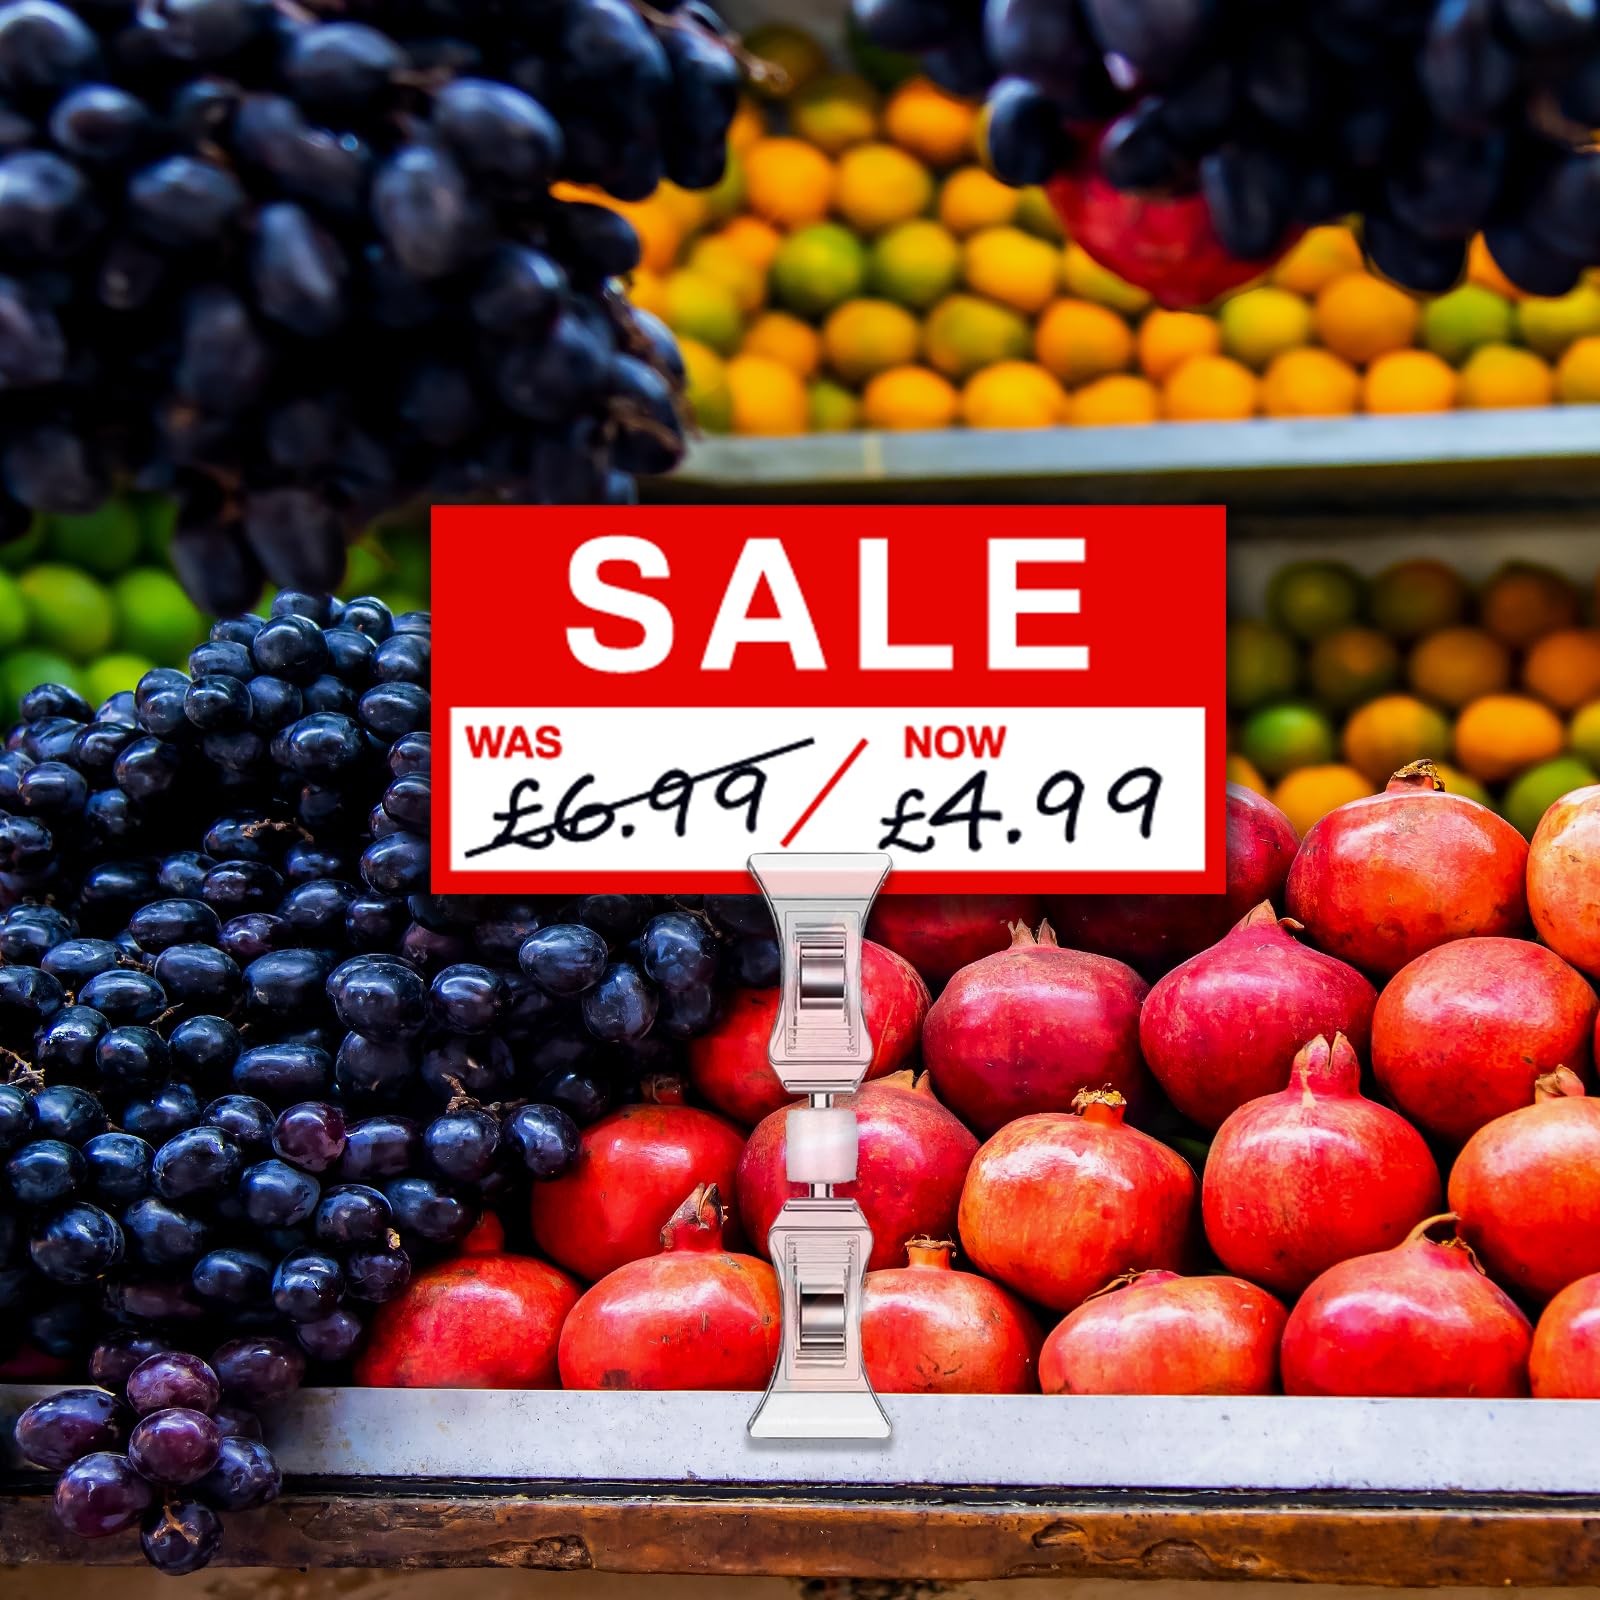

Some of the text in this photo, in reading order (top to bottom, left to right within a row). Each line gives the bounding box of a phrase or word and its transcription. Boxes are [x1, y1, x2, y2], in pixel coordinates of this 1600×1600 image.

[566, 535, 1090, 674] SALE
[465, 725, 563, 760] WAS
[904, 725, 1007, 760] NOW
[492, 765, 768, 850] £6.99
[878, 766, 1163, 854] £4.99
